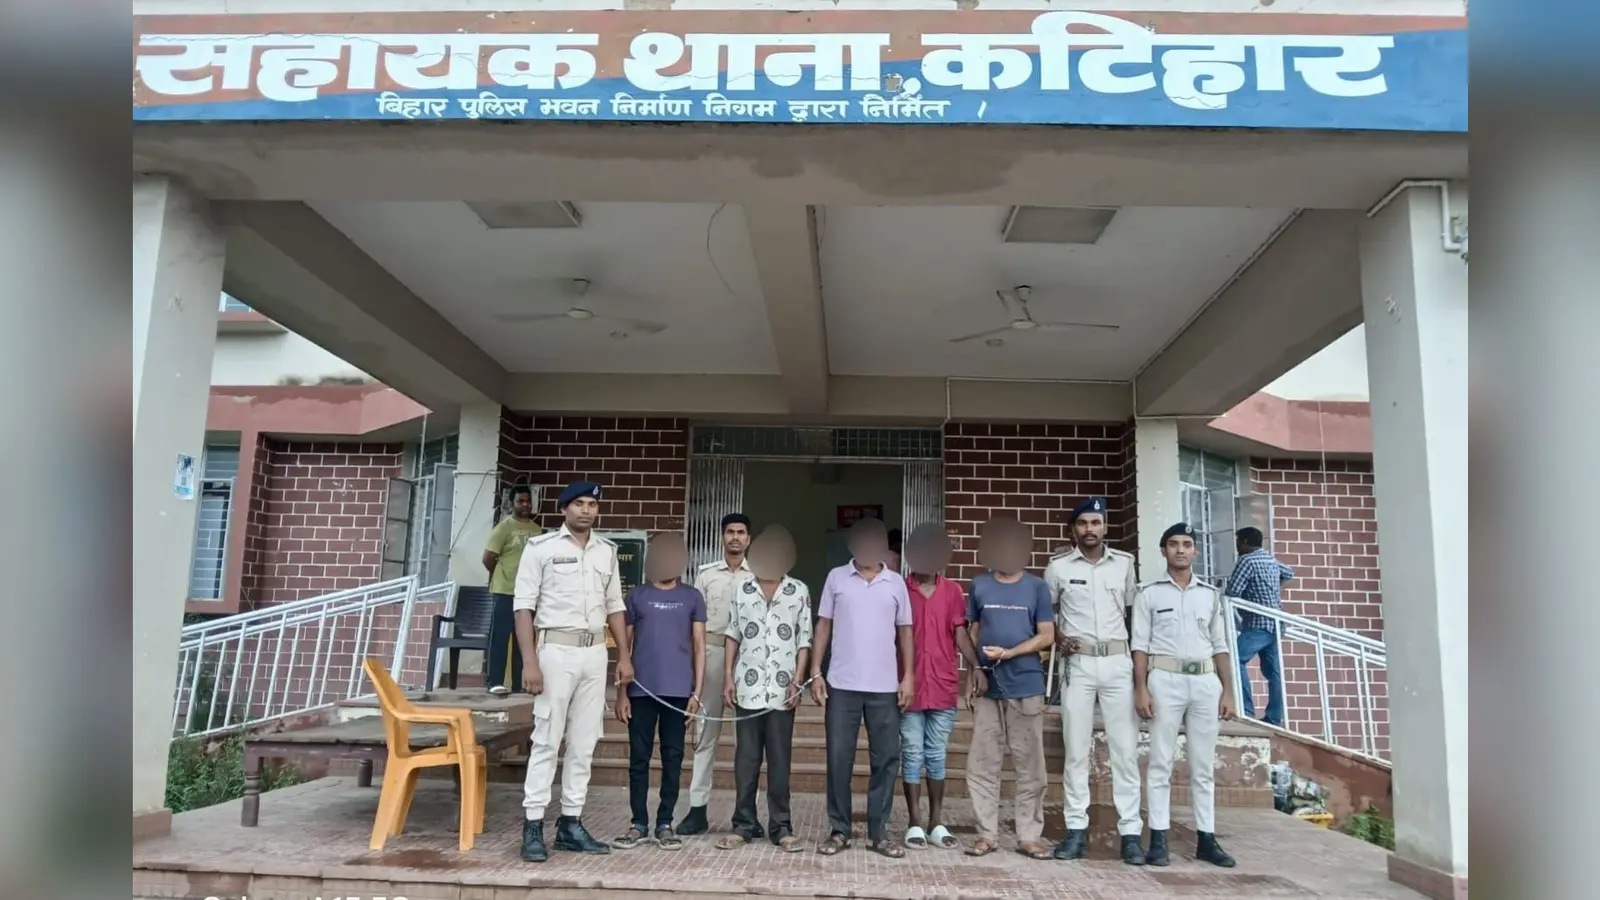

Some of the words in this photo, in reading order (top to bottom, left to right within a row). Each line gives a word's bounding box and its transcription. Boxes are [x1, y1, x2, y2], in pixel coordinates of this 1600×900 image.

[135, 33, 599, 102] सहायक
[921, 11, 1395, 109] कटिहार
[376, 91, 449, 118] बिहार
[457, 92, 528, 119] पुलिस
[540, 99, 601, 117] भवन
[609, 92, 693, 117] निर्माण
[702, 92, 777, 118] निगम
[787, 100, 850, 122] द्वारा
[858, 93, 951, 119] निर्मित
